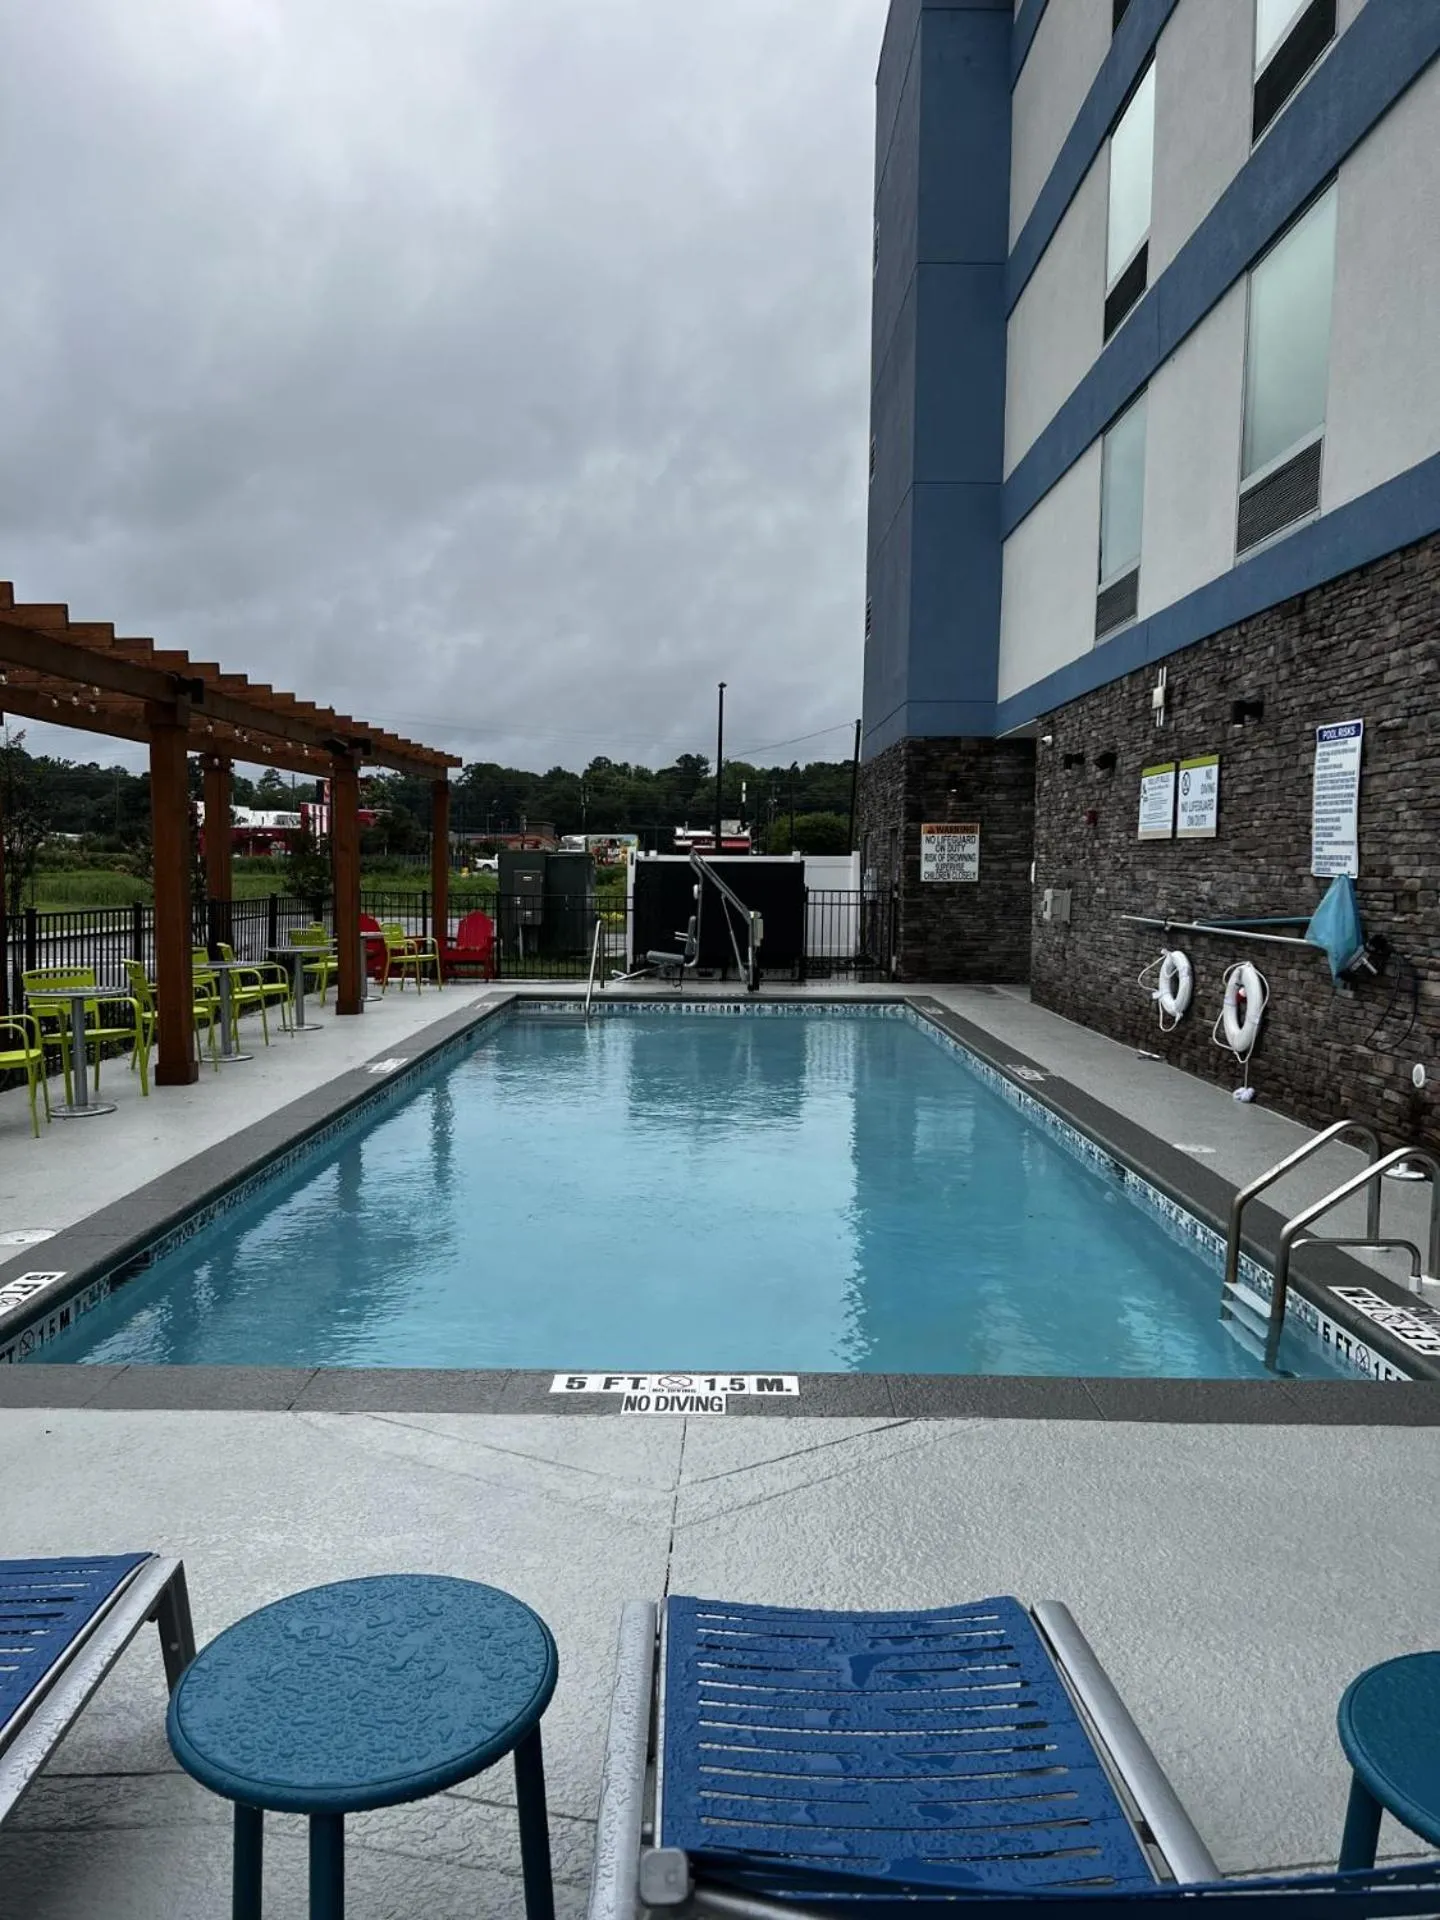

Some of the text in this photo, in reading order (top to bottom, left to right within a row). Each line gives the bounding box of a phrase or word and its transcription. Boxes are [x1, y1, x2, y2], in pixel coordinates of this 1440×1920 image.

[1322, 726, 1356, 740] POOL RISKS
[925, 836, 976, 844] NO LIFEGUARD
[938, 854, 946, 862] OF
[947, 854, 976, 862] DROWNING
[935, 863, 965, 871] SUPERVISE
[924, 872, 976, 880] CHILDREN CLOSELY
[1322, 1321, 1331, 1344] 5
[565, 1376, 588, 1390] 5
[704, 1377, 747, 1392] 1.5
[623, 1395, 723, 1413] NO DIVING
